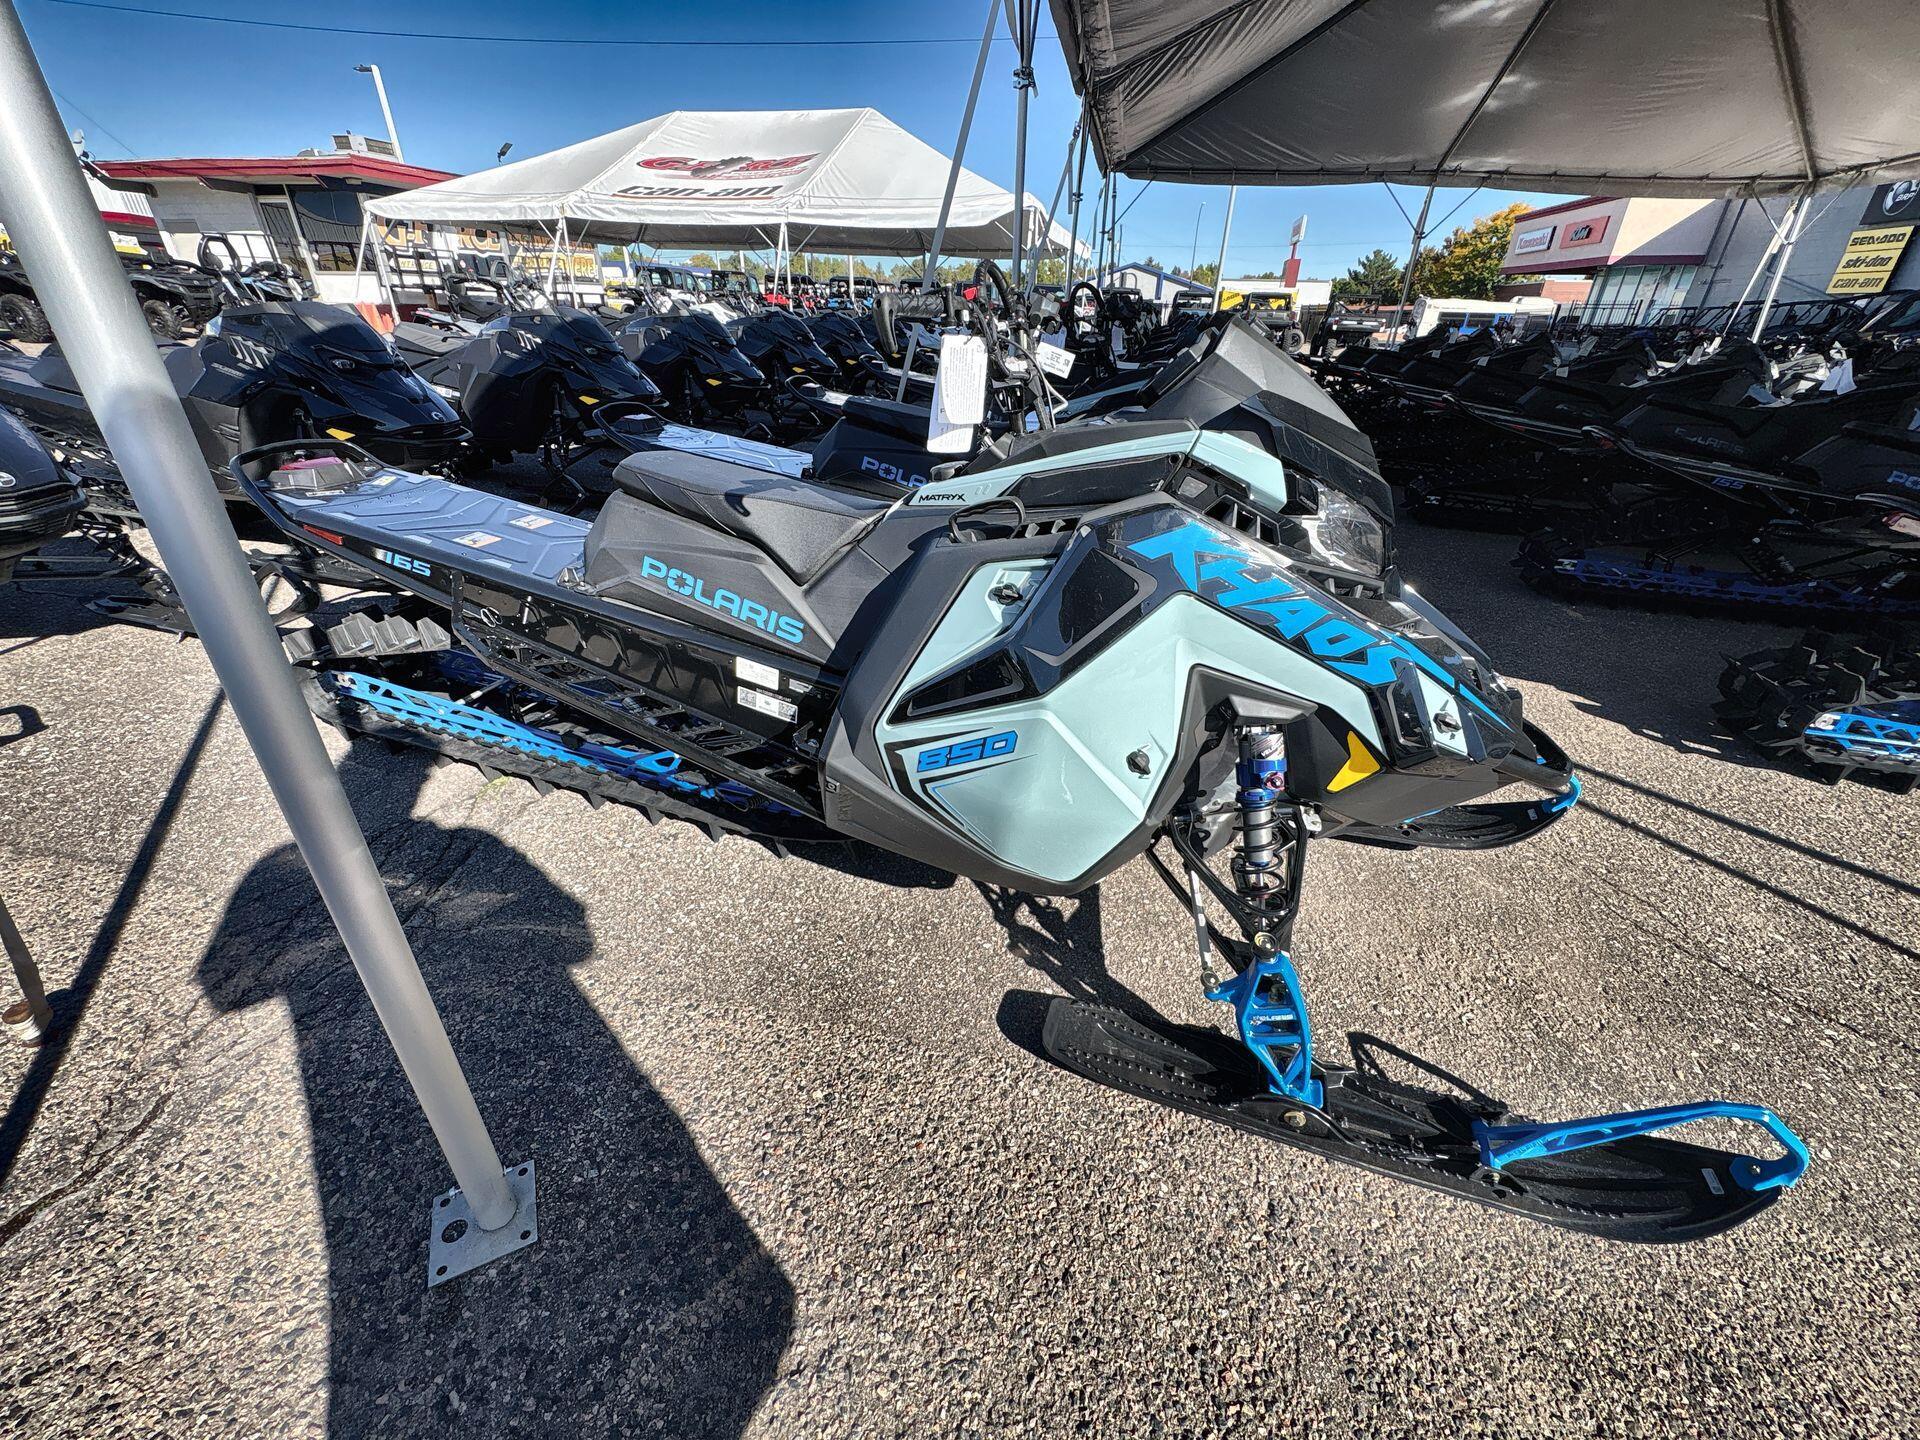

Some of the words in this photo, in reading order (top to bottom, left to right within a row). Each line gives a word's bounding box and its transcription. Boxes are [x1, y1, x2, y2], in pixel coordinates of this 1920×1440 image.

[1711, 476, 1748, 490] 155
[919, 493, 966, 503] MATRYX
[382, 550, 432, 577] 165
[640, 555, 804, 644] POLARIS
[917, 730, 1019, 773] 850
